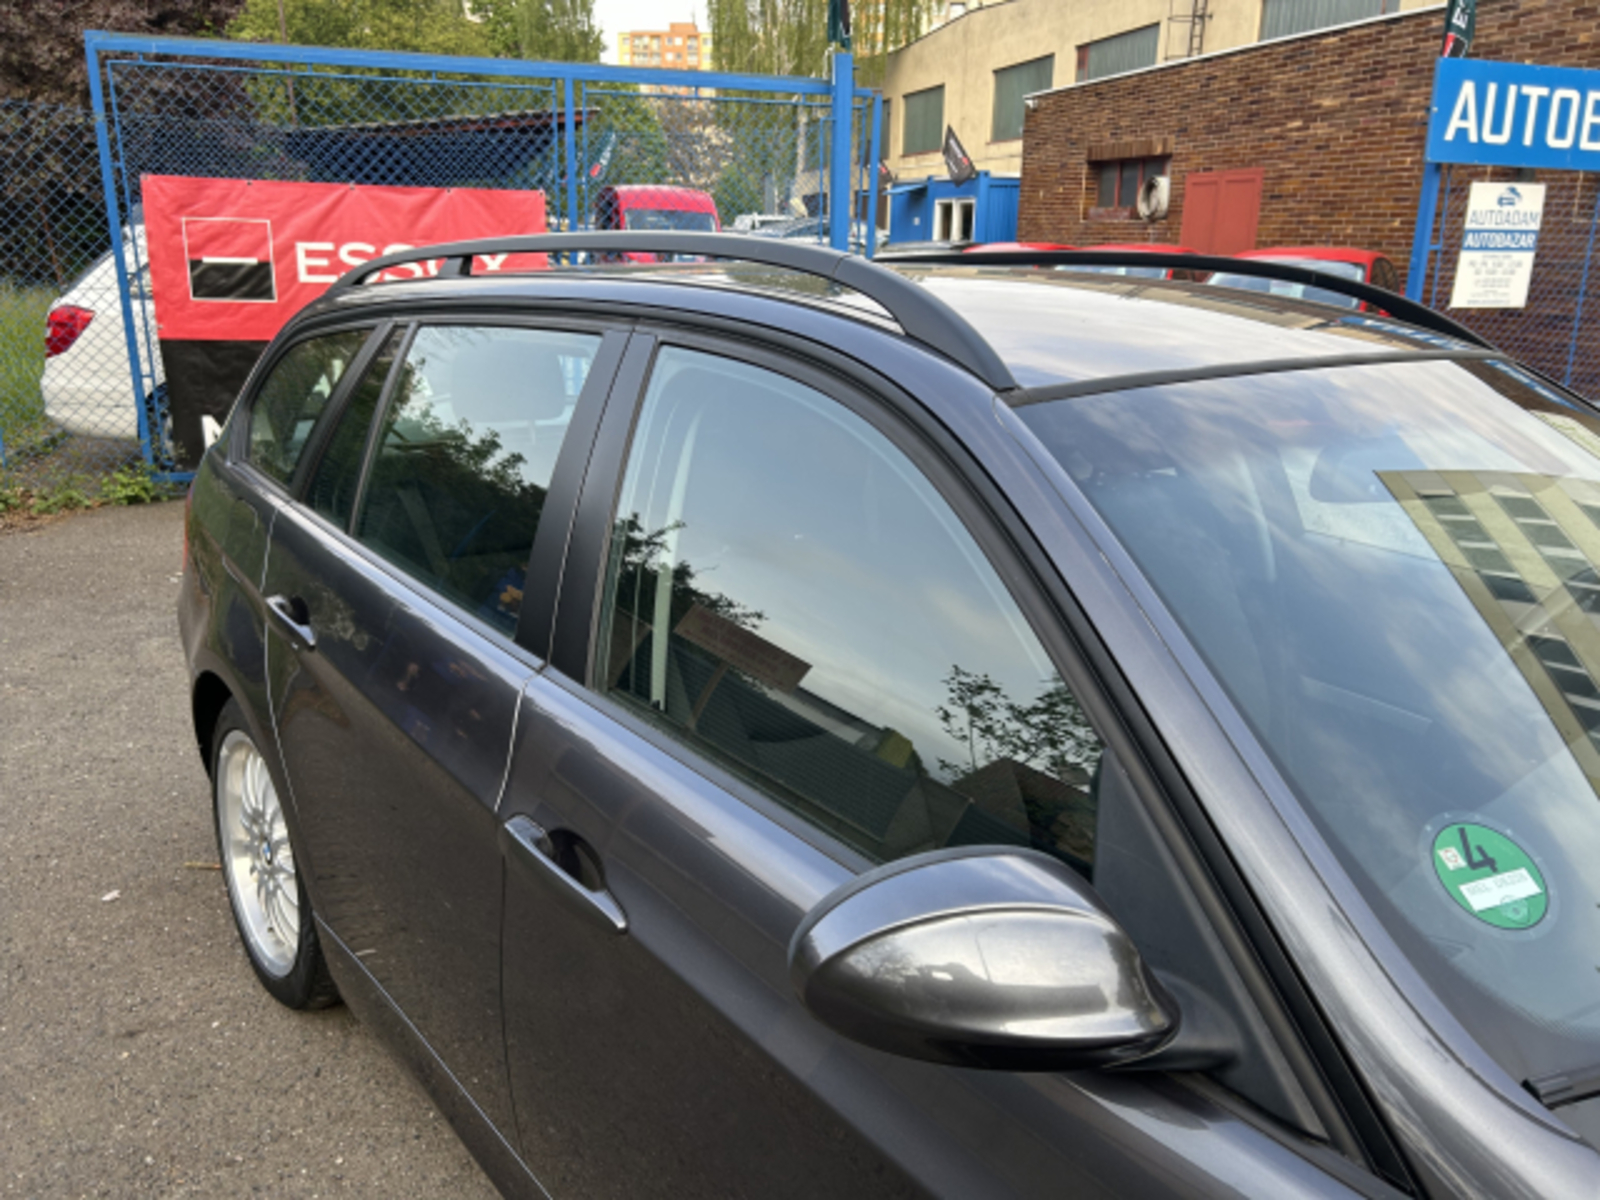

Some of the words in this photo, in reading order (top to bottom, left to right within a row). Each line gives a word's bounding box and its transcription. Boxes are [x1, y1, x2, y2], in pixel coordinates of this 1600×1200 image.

[1468, 209, 1540, 226] AUTOADAM
[1464, 231, 1536, 249] AUTOBAZAR
[1457, 827, 1498, 873] 4
